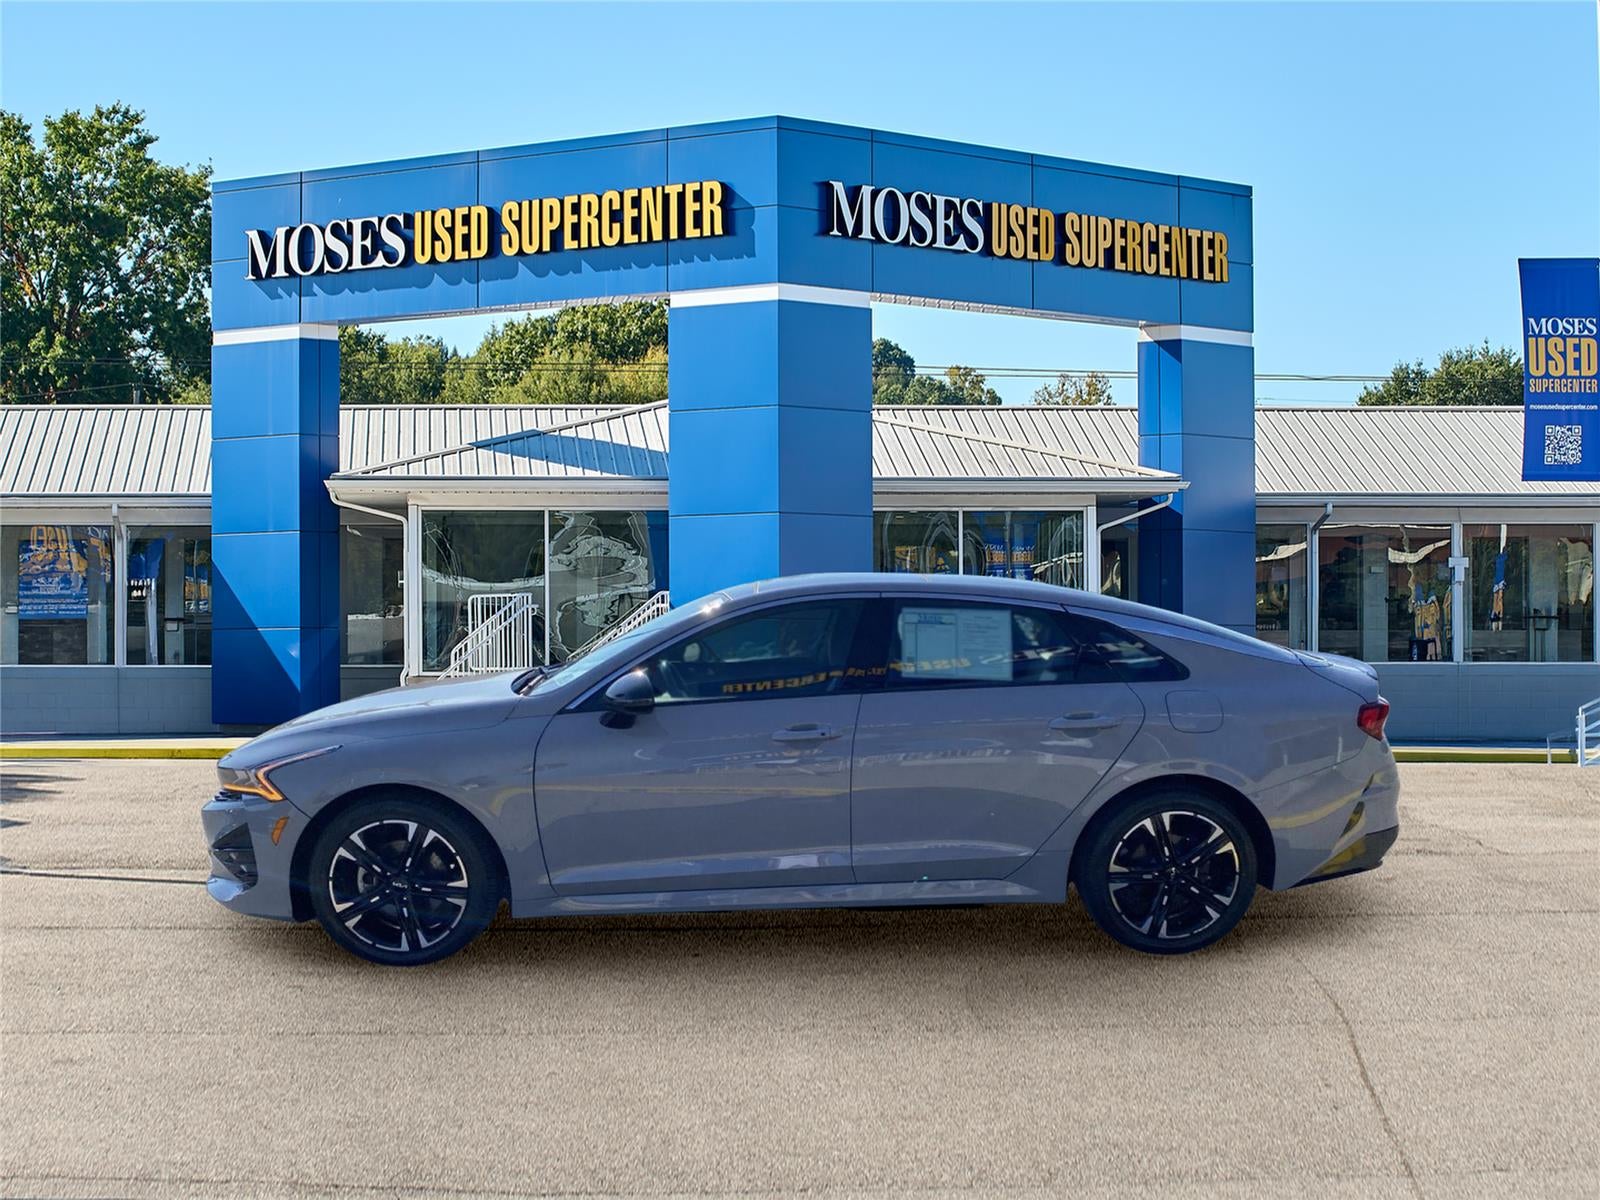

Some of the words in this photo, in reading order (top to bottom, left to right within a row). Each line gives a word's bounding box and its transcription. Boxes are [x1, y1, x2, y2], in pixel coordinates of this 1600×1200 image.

[244, 213, 406, 281] MOSES
[413, 204, 489, 265] USED
[500, 180, 723, 257] SUPERCENTER
[828, 180, 985, 254] MOSES
[991, 202, 1055, 262] USED
[1064, 211, 1229, 283] SUPERCENTER
[1527, 317, 1597, 336] MOSES
[1528, 337, 1598, 377] USED
[1529, 378, 1598, 394] SUPERCENTER
[1529, 403, 1598, 411] mosesusedsupercenter.com
